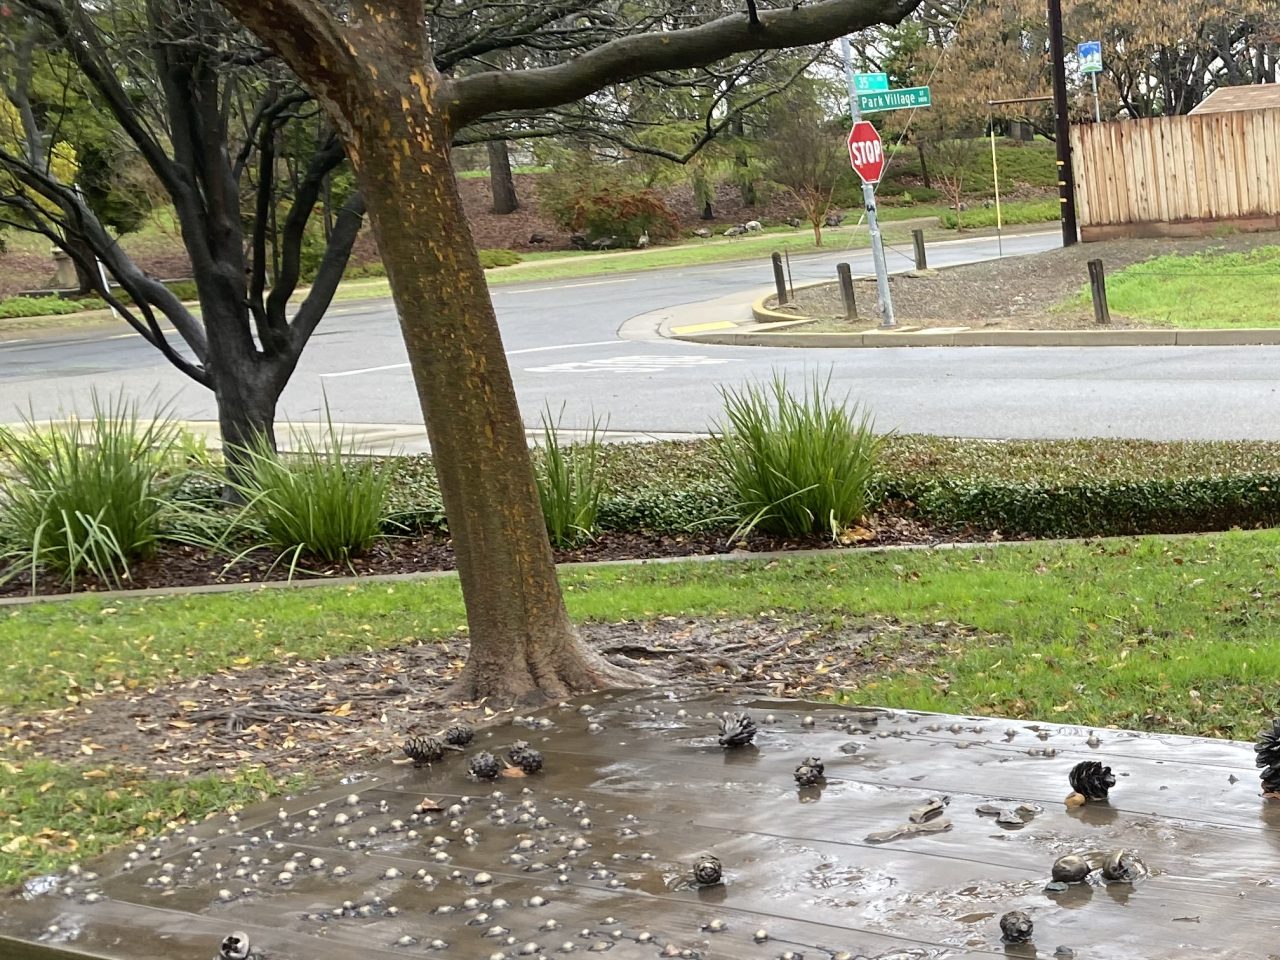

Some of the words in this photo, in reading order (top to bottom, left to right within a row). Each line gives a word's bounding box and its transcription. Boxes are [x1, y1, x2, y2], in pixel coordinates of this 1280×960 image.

[861, 95, 884, 109] Park
[884, 93, 916, 107] Village
[851, 140, 881, 166] STOP
